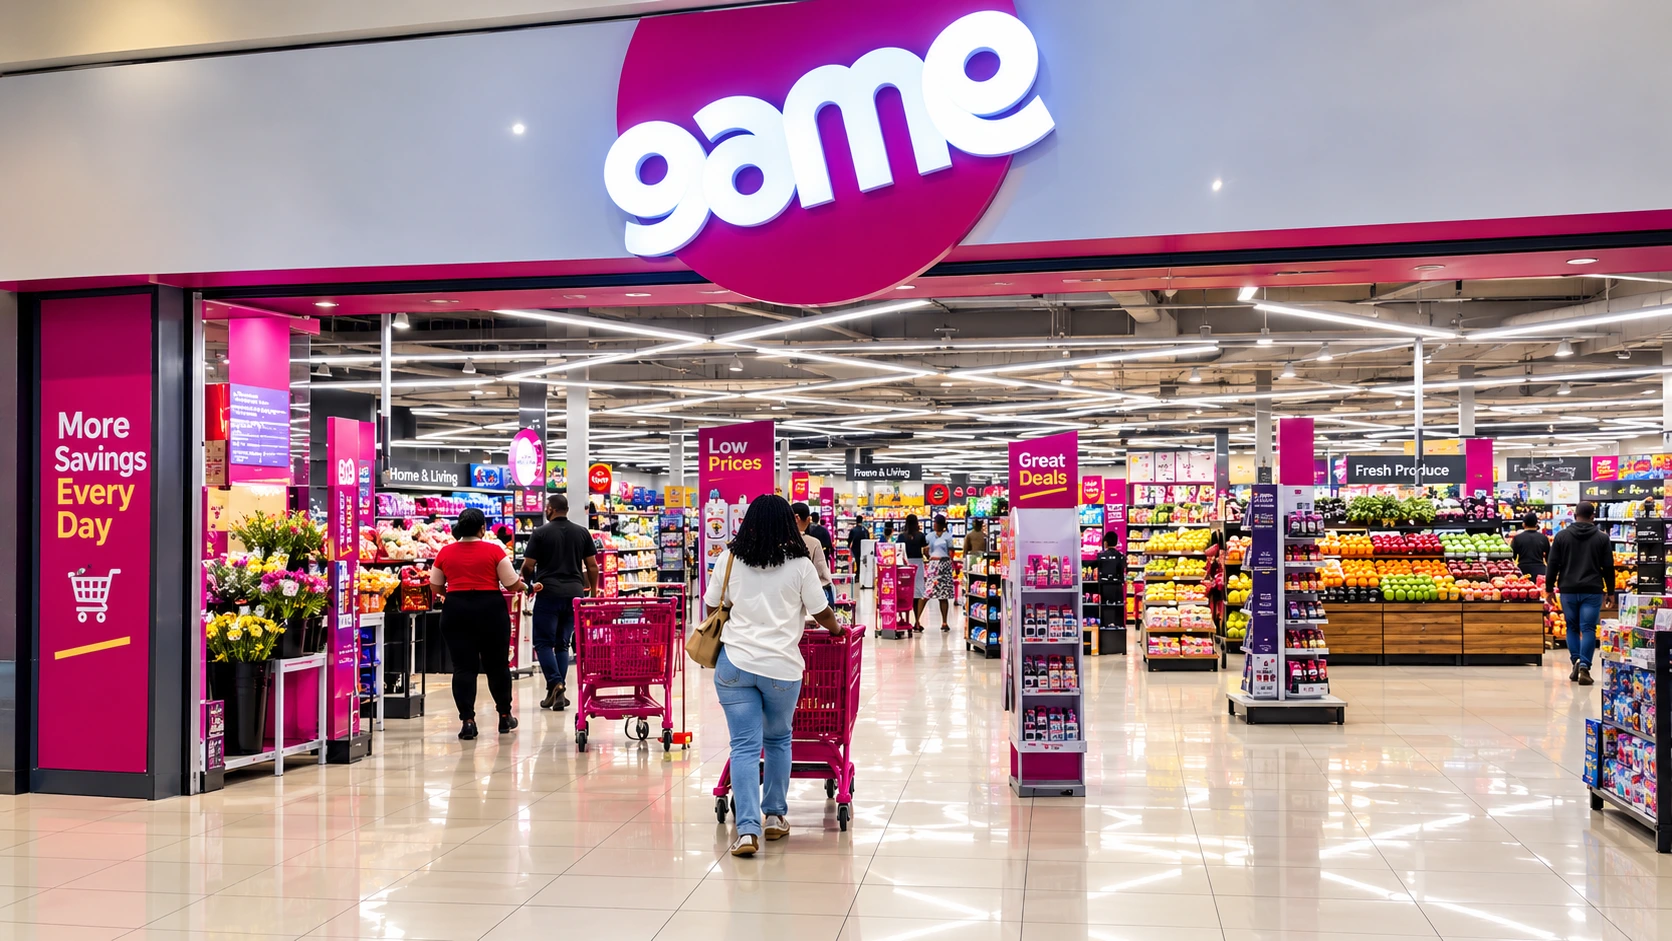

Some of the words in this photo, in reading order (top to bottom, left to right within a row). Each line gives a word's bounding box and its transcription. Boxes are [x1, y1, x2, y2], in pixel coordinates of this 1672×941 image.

[604, 10, 1056, 258] game
[58, 411, 131, 439] More
[708, 437, 748, 454] Low
[54, 444, 147, 477] Savings
[708, 455, 762, 472] Prices
[1019, 452, 1066, 468] Great
[1355, 464, 1392, 476] Fresh
[390, 467, 419, 482] Home
[421, 469, 429, 482] &
[430, 469, 458, 487] Living
[1019, 469, 1067, 486] Deals
[57, 477, 135, 511] Every
[57, 510, 113, 546] Day
